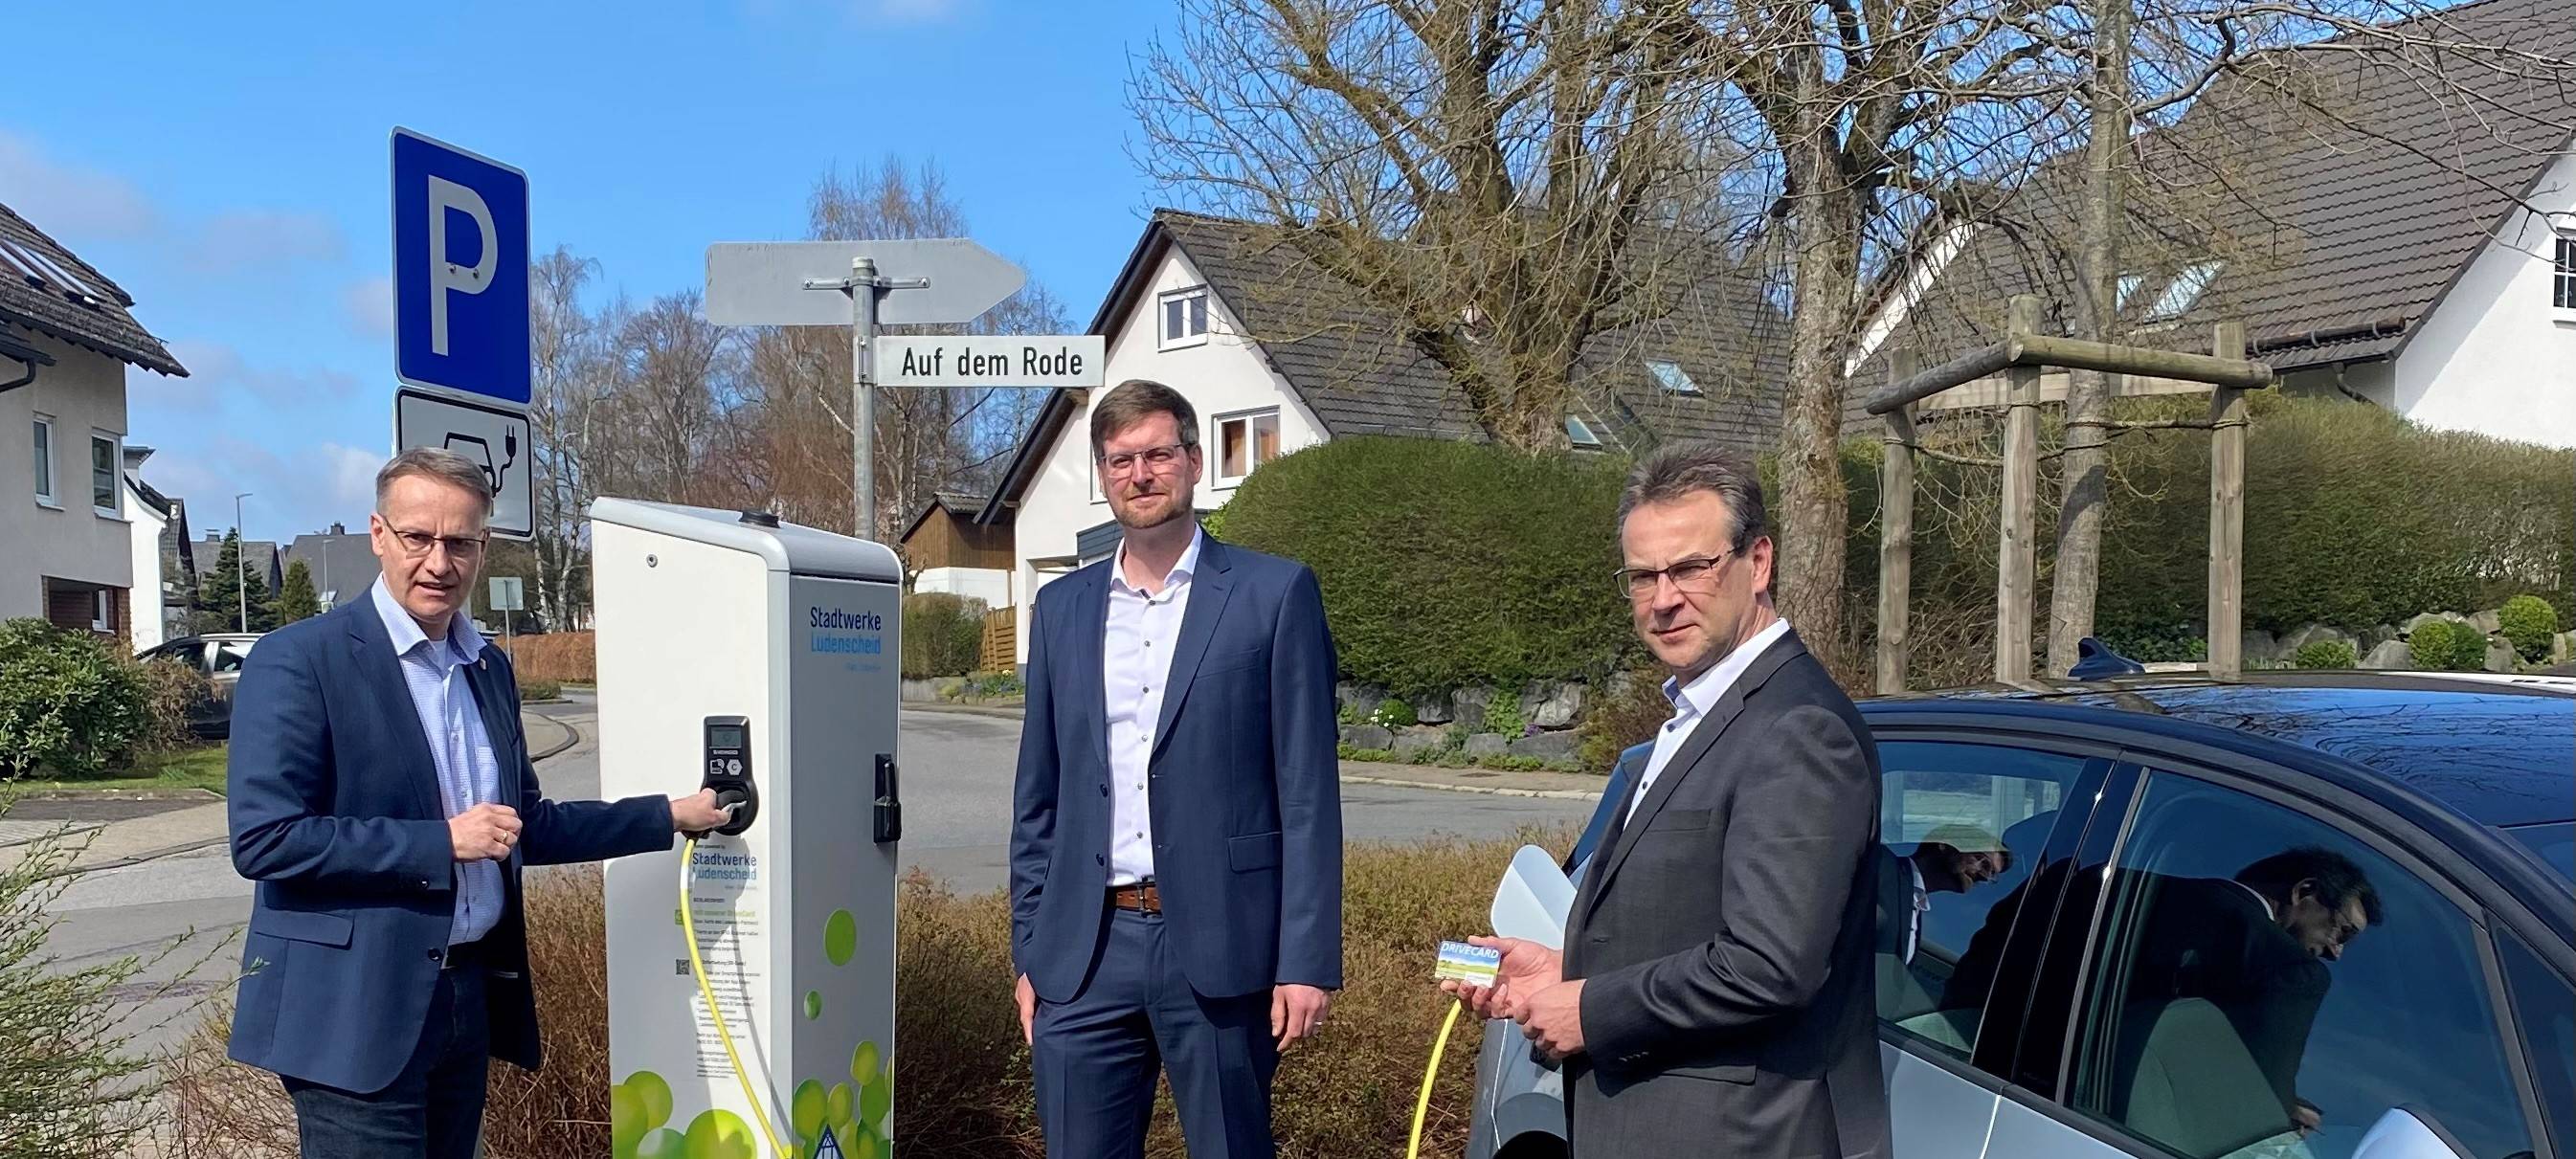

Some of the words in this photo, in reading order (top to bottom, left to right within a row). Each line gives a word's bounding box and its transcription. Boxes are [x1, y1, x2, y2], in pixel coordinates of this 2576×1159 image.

[428, 174, 498, 357] P
[901, 346, 944, 376] Auf
[957, 346, 1009, 376] dem
[1023, 345, 1084, 376] Rode
[810, 606, 882, 631] Stadtwerke
[692, 852, 757, 866] Stadtwerke
[1441, 943, 1500, 959] DRIVECARD
